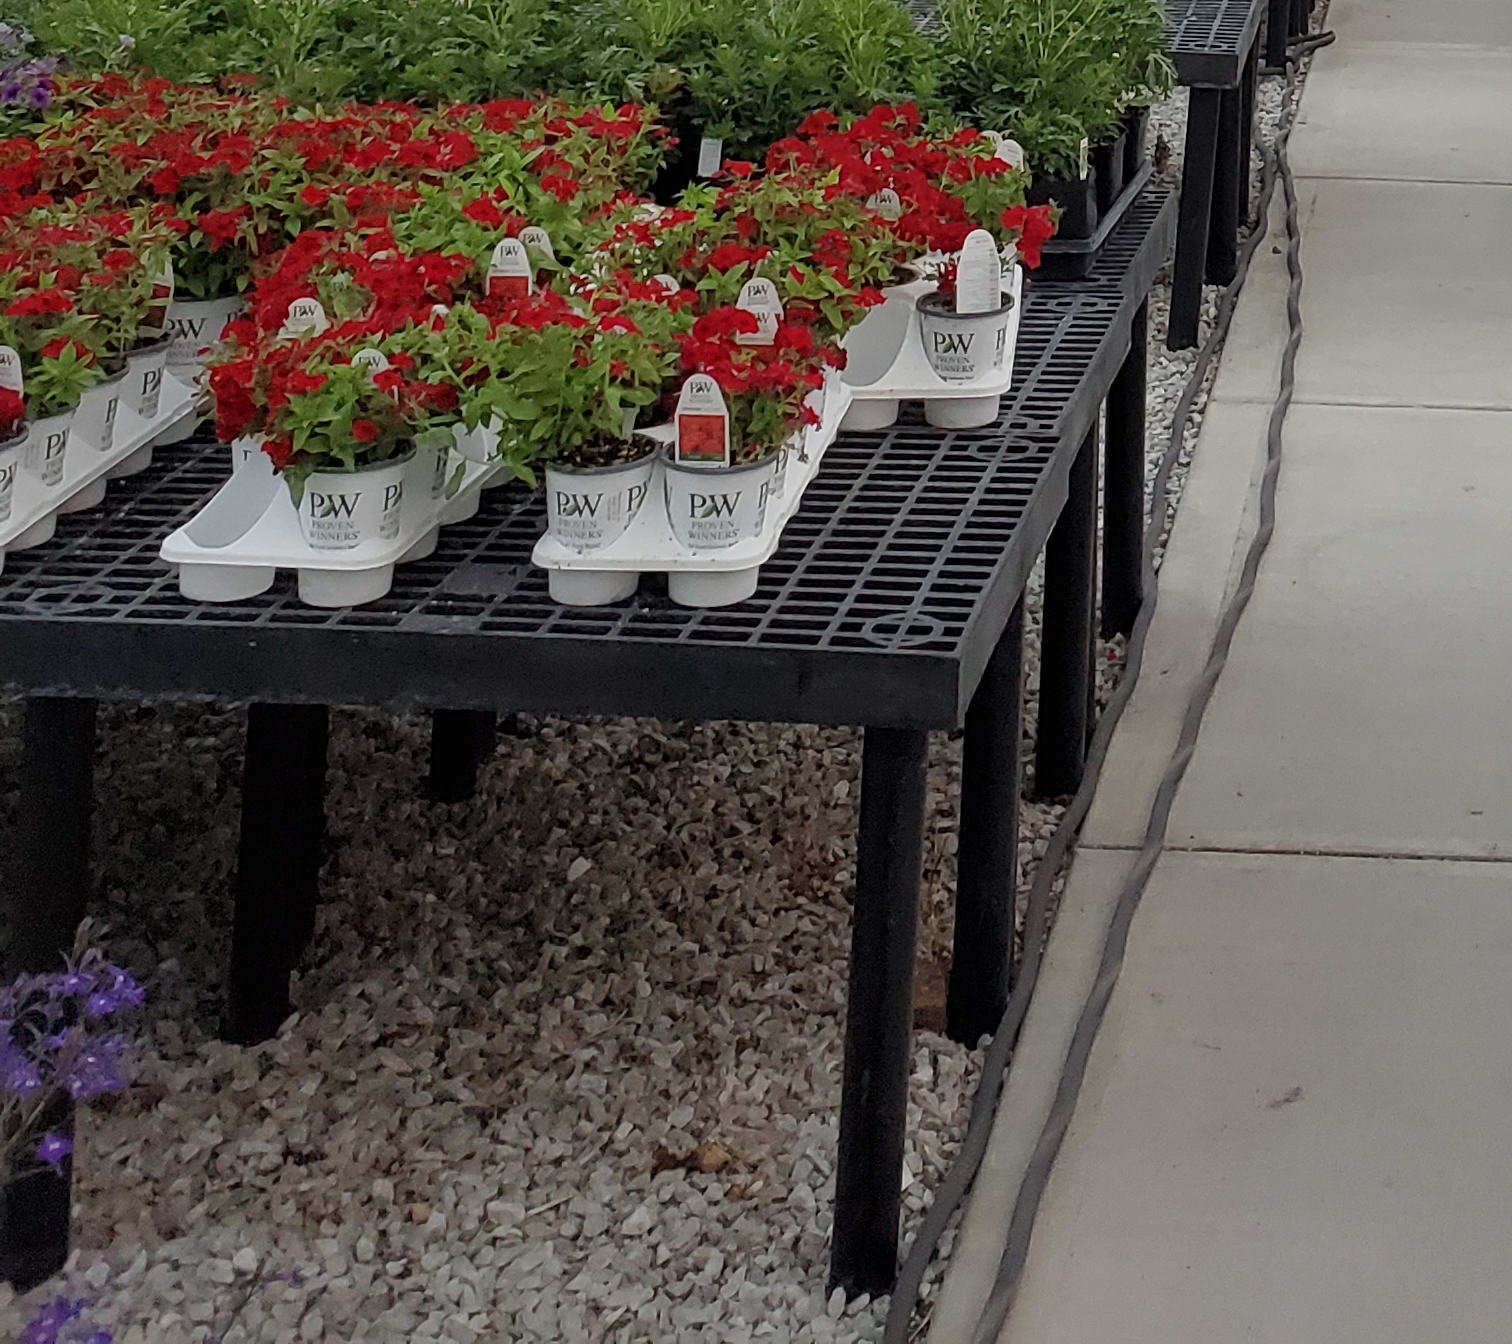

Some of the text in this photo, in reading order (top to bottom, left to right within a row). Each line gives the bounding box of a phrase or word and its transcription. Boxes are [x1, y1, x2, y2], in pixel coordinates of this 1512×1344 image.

[933, 331, 976, 355] PW
[309, 491, 363, 519] PW
[556, 490, 603, 519] PW
[688, 490, 743, 519] PW
